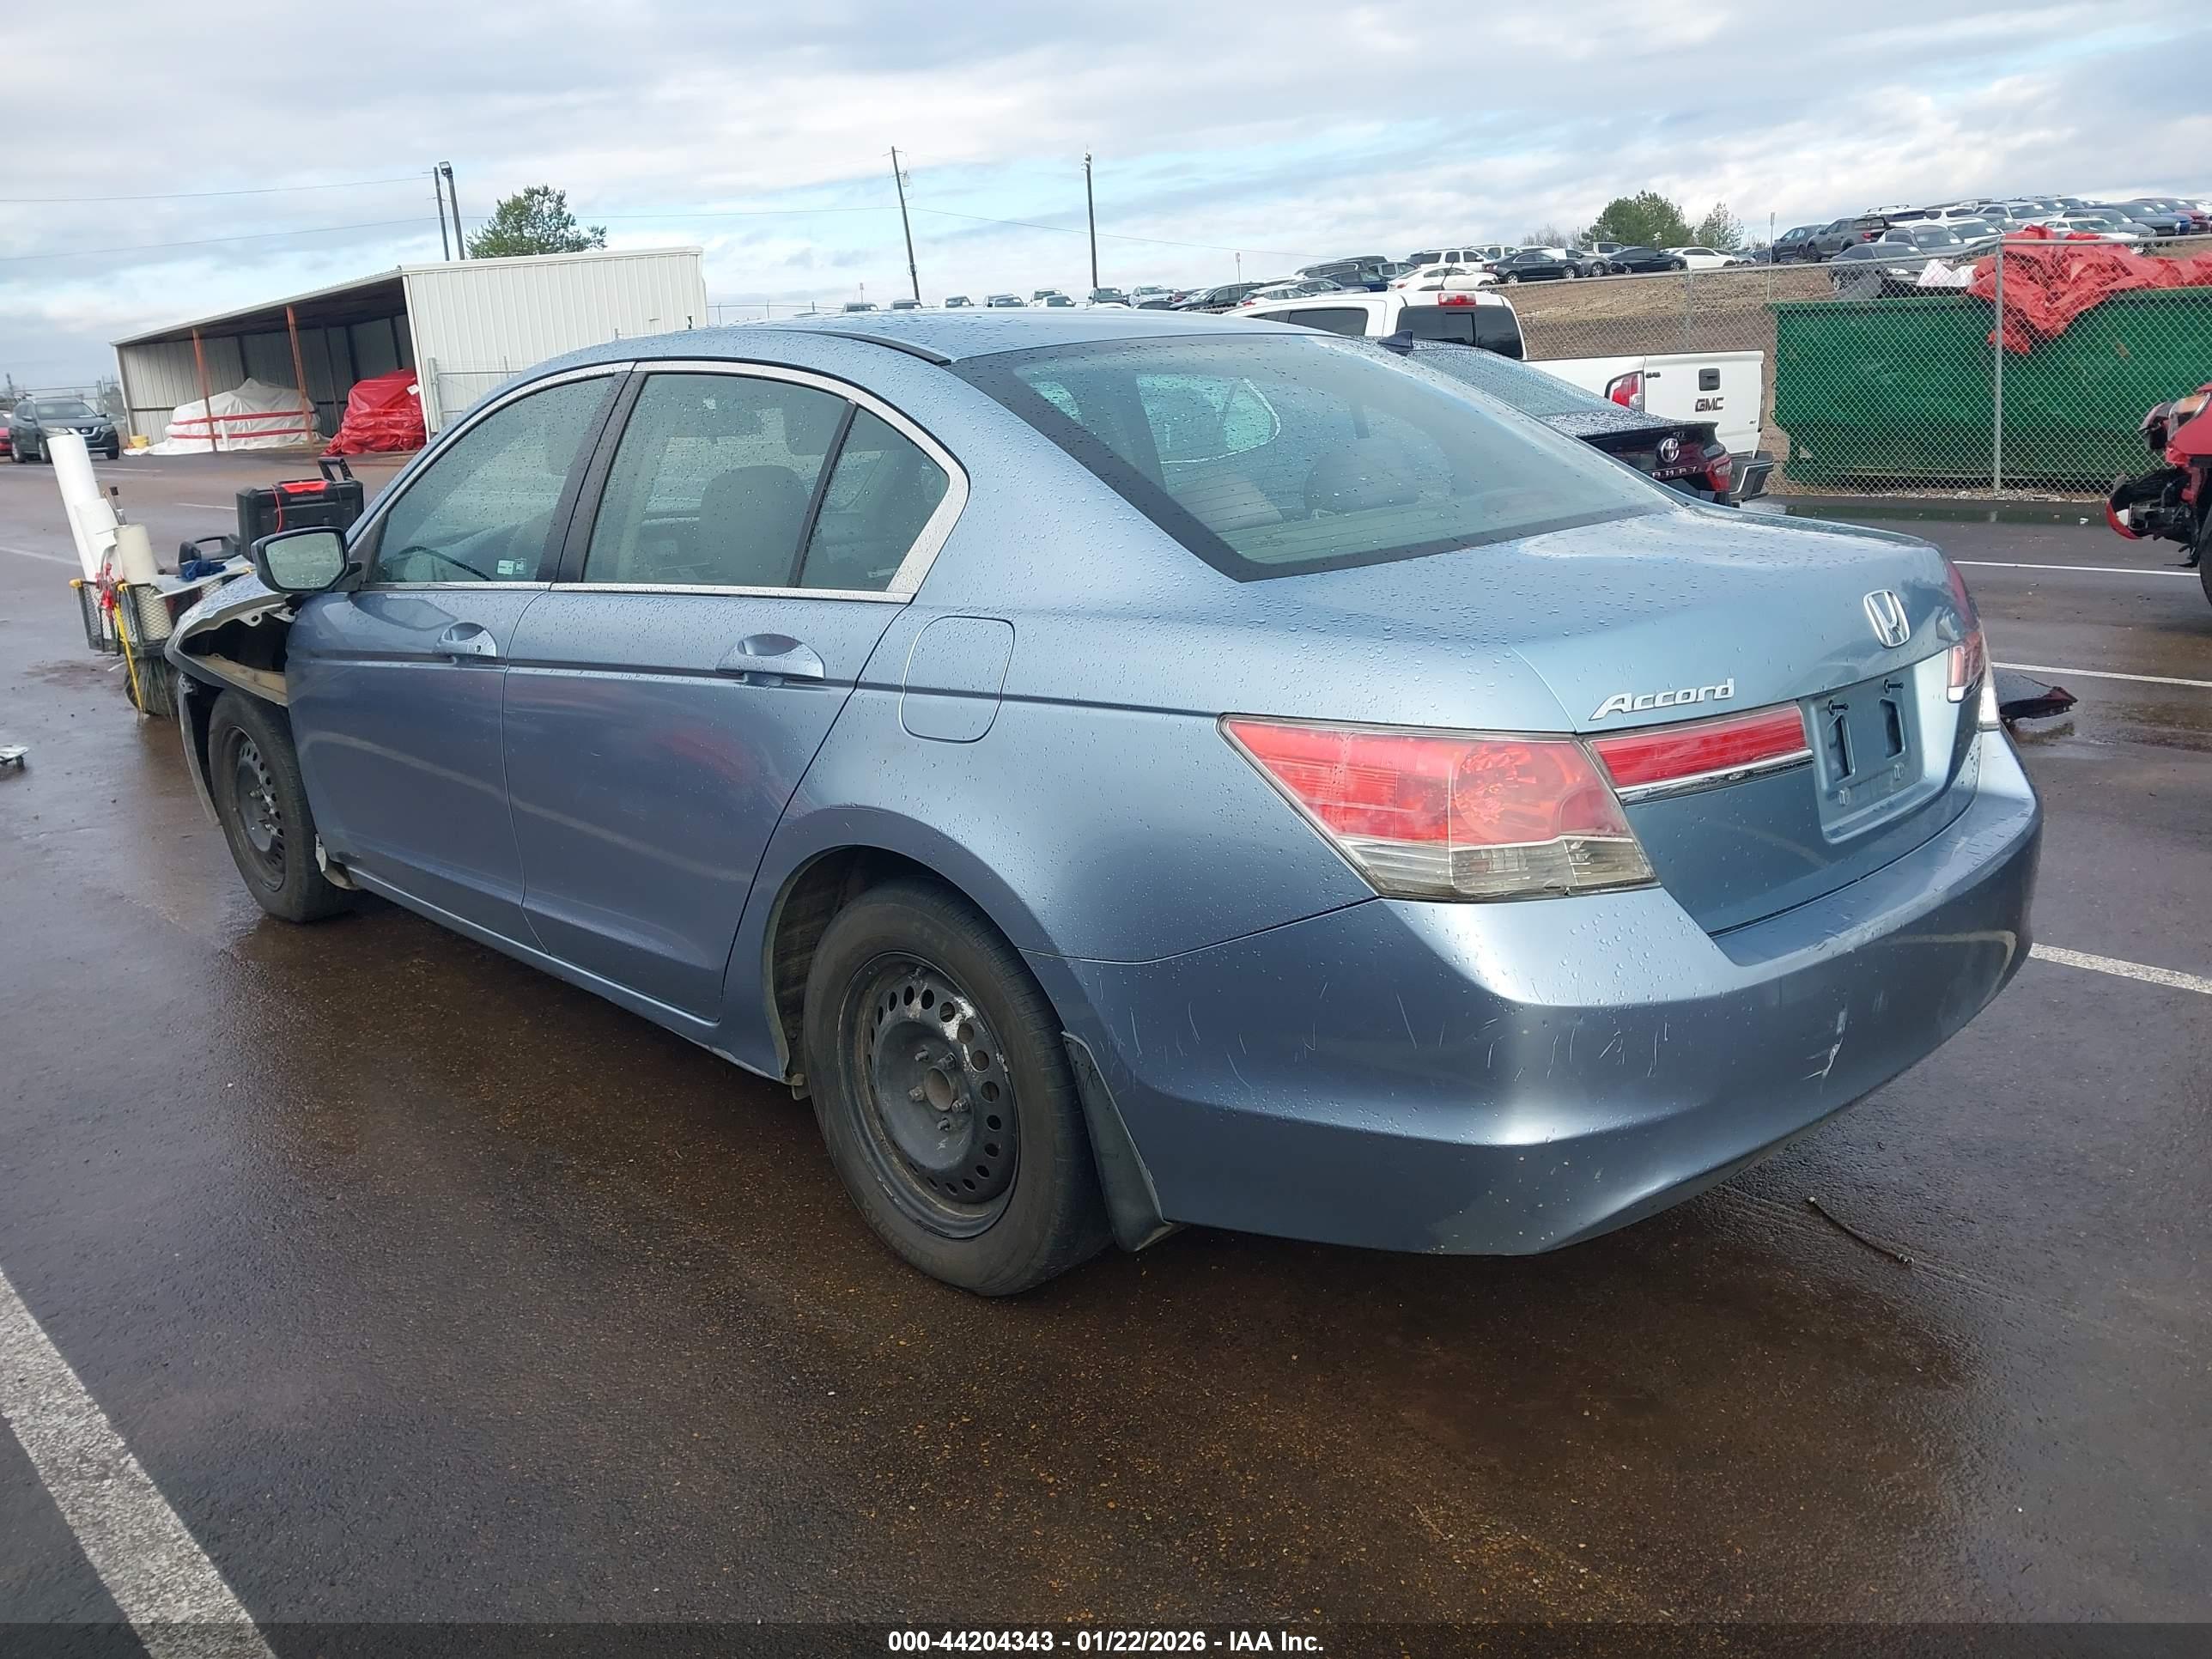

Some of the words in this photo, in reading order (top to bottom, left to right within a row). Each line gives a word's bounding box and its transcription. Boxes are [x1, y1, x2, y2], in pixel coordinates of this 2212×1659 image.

[1695, 397, 1724, 412] GMC
[1651, 465, 1698, 478] AMRY
[1589, 678, 1735, 721] Accord
